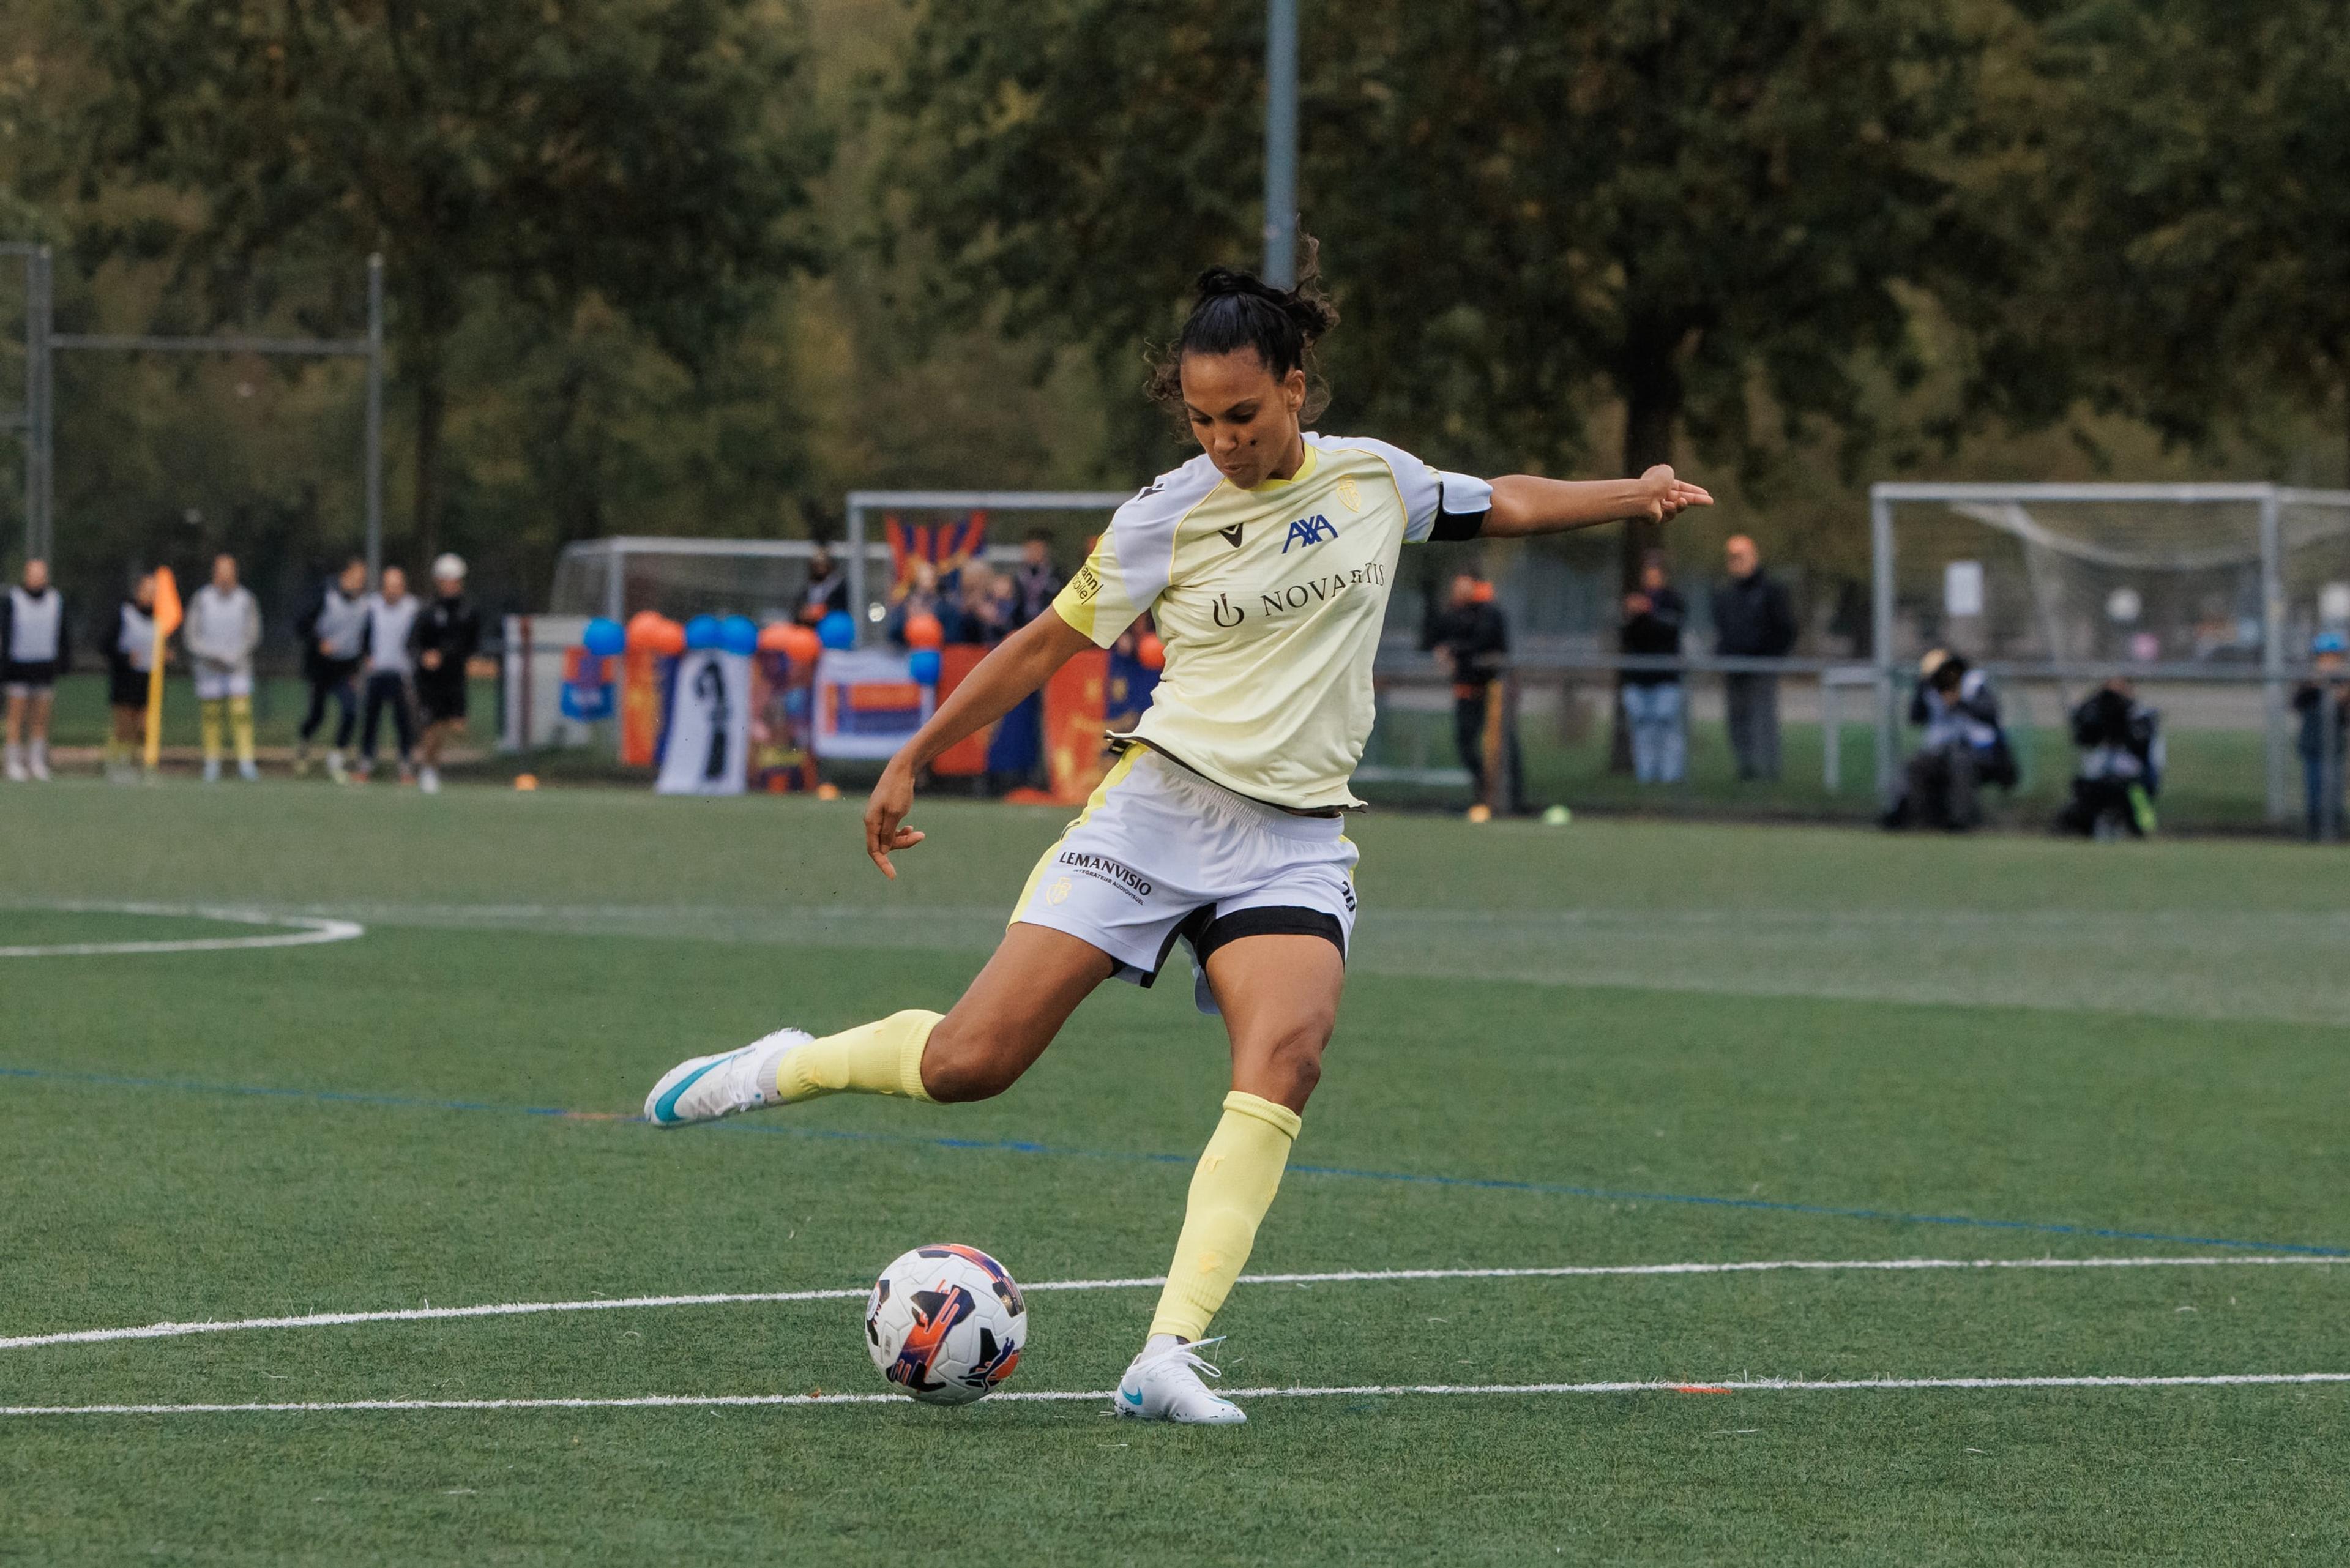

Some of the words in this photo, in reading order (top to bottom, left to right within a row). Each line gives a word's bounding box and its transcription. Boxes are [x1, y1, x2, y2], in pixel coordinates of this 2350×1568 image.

[1281, 514, 1338, 554] AXA
[1081, 564, 1098, 590] ann
[1059, 851, 1152, 895] LEMANVISIO
